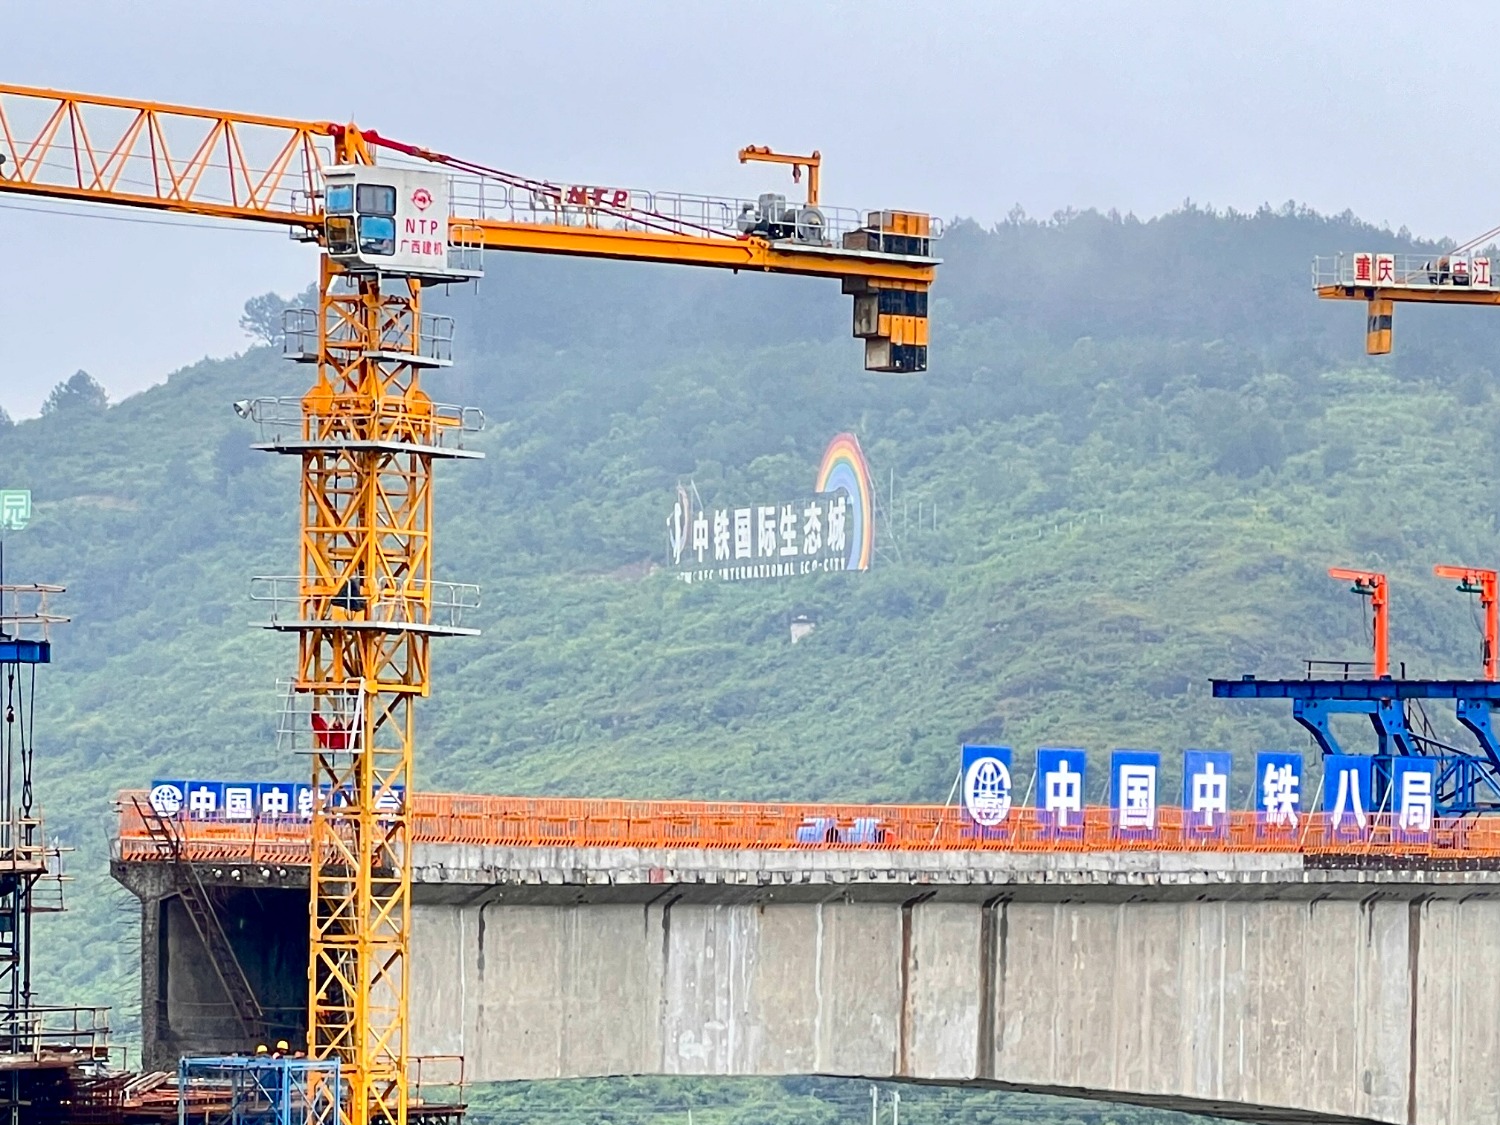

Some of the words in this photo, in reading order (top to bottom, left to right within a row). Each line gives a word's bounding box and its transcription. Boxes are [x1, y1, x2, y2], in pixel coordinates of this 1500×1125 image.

[567, 186, 628, 208] NTP
[405, 218, 438, 235] NTP
[400, 239, 443, 256] 广西建机
[692, 496, 847, 563] 中铁国际生态城
[718, 561, 795, 581] INTERNATIONAL
[800, 557, 846, 574] ECO-CITY
[1045, 760, 1433, 833] 中国中铁八局
